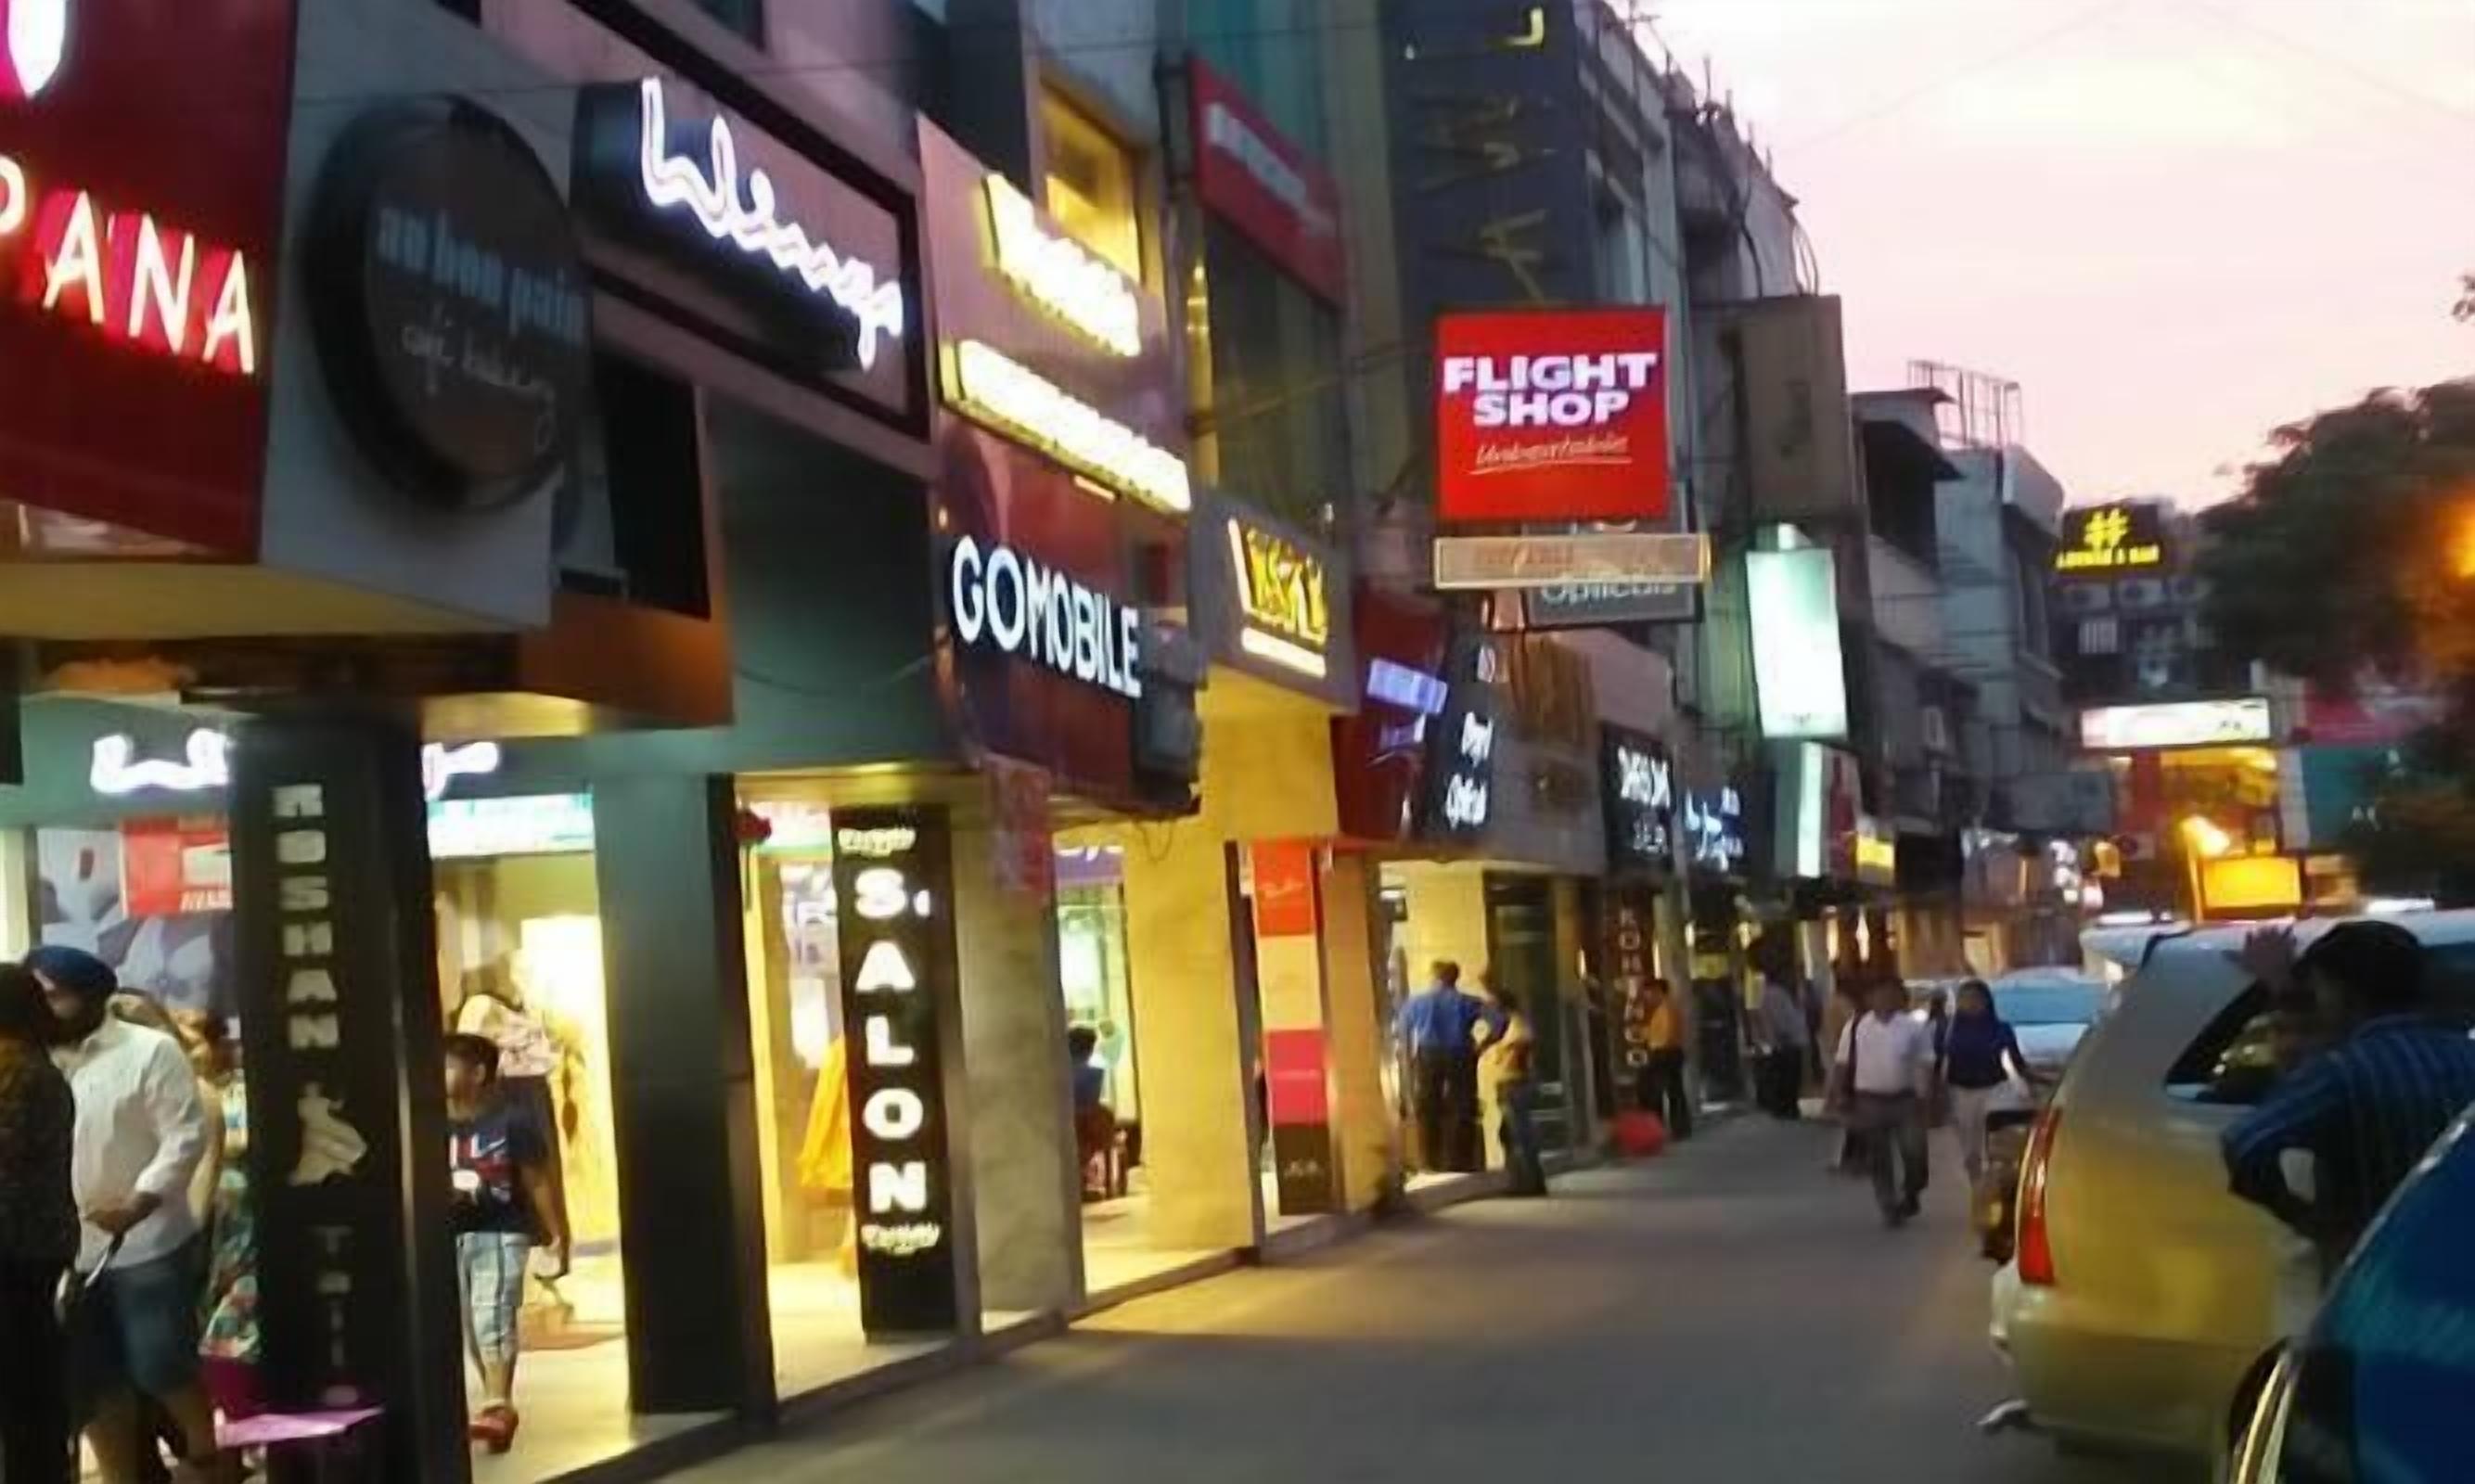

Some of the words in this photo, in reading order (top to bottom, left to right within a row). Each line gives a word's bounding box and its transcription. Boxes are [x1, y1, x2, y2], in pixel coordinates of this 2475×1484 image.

[1443, 352, 1657, 392] FLIGHT
[1473, 390, 1630, 427] SHOP
[953, 534, 1142, 697] GOMOBILE
[853, 867, 927, 1213] SALON
